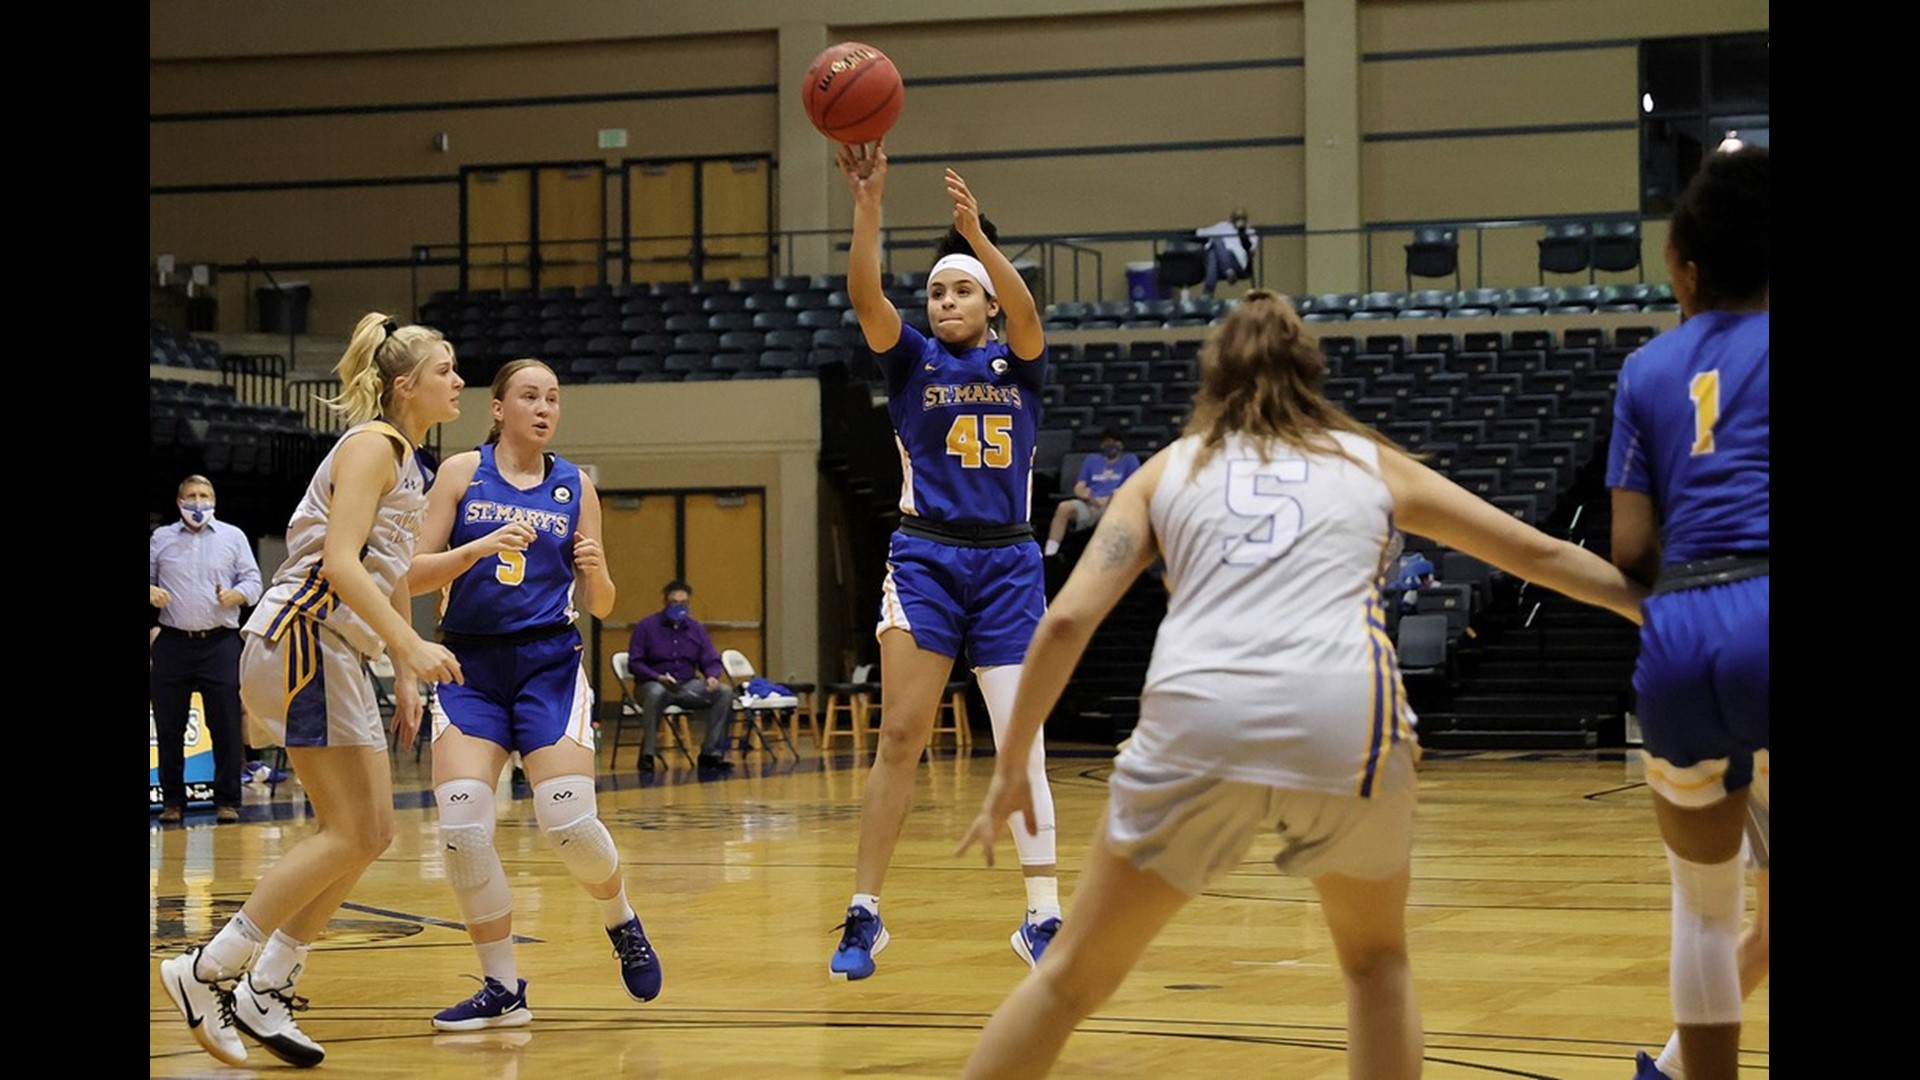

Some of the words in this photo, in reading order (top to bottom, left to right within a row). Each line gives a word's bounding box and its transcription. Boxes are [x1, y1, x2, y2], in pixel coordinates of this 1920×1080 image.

[946, 414, 1012, 468] 45
[1689, 369, 1719, 456] 1
[1222, 459, 1308, 567] 5
